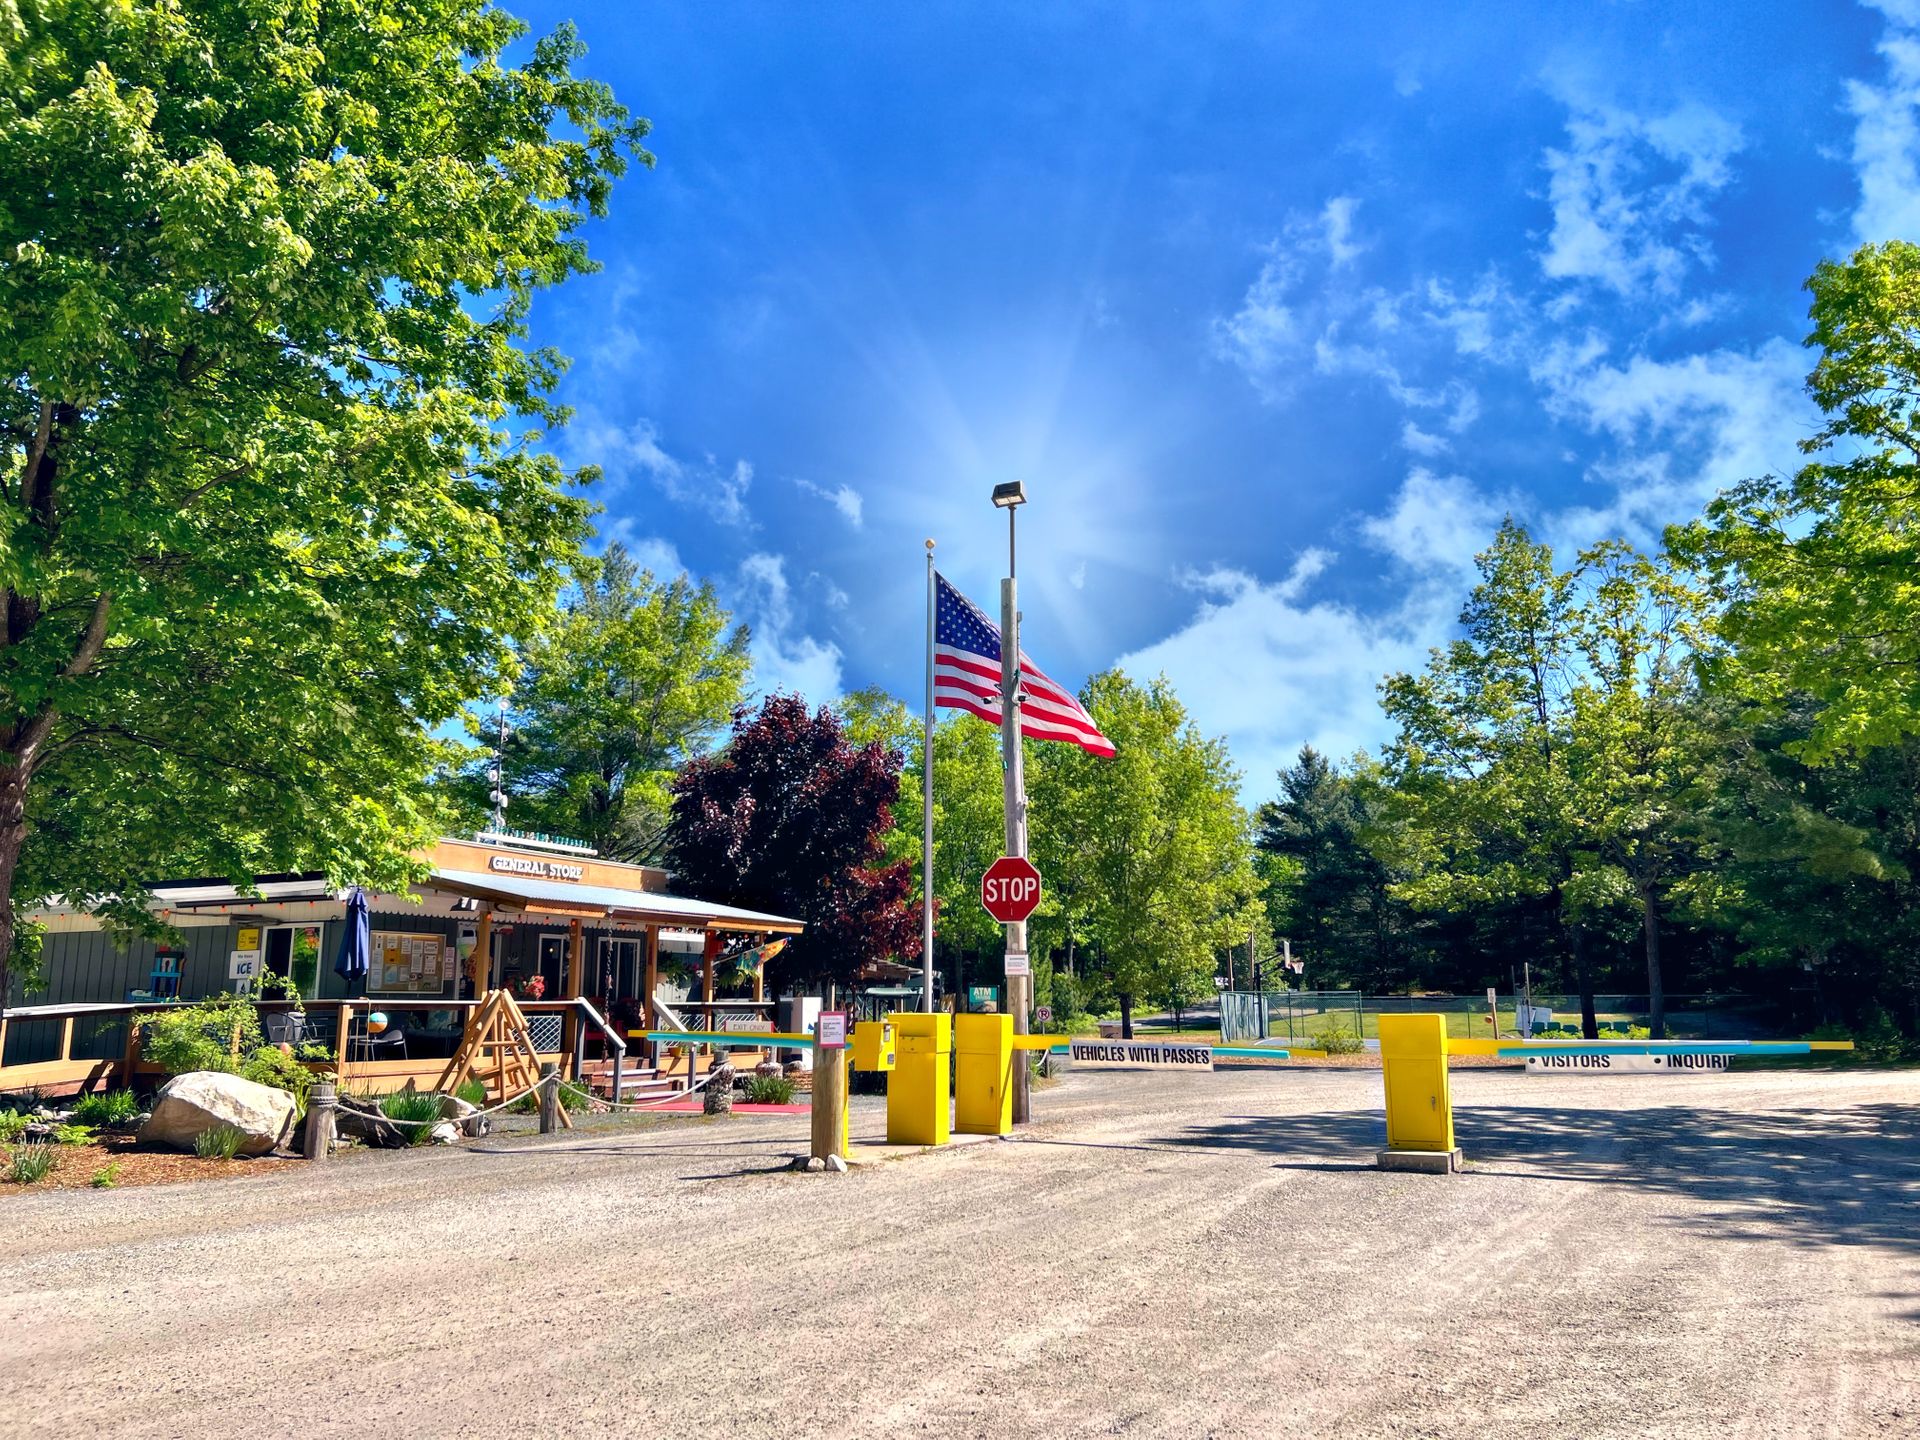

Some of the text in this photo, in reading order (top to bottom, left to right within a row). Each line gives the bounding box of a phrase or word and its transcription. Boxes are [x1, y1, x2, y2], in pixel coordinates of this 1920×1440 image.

[492, 856, 583, 880] GENERAL STORE
[985, 877, 1037, 903] STOP
[236, 962, 252, 975] ICE
[973, 987, 992, 996] ATM
[733, 1023, 766, 1032] EXIT ONLY
[1072, 1045, 1210, 1065] VEHICLES WITH PASSES
[1541, 1054, 1611, 1068] VISITORS
